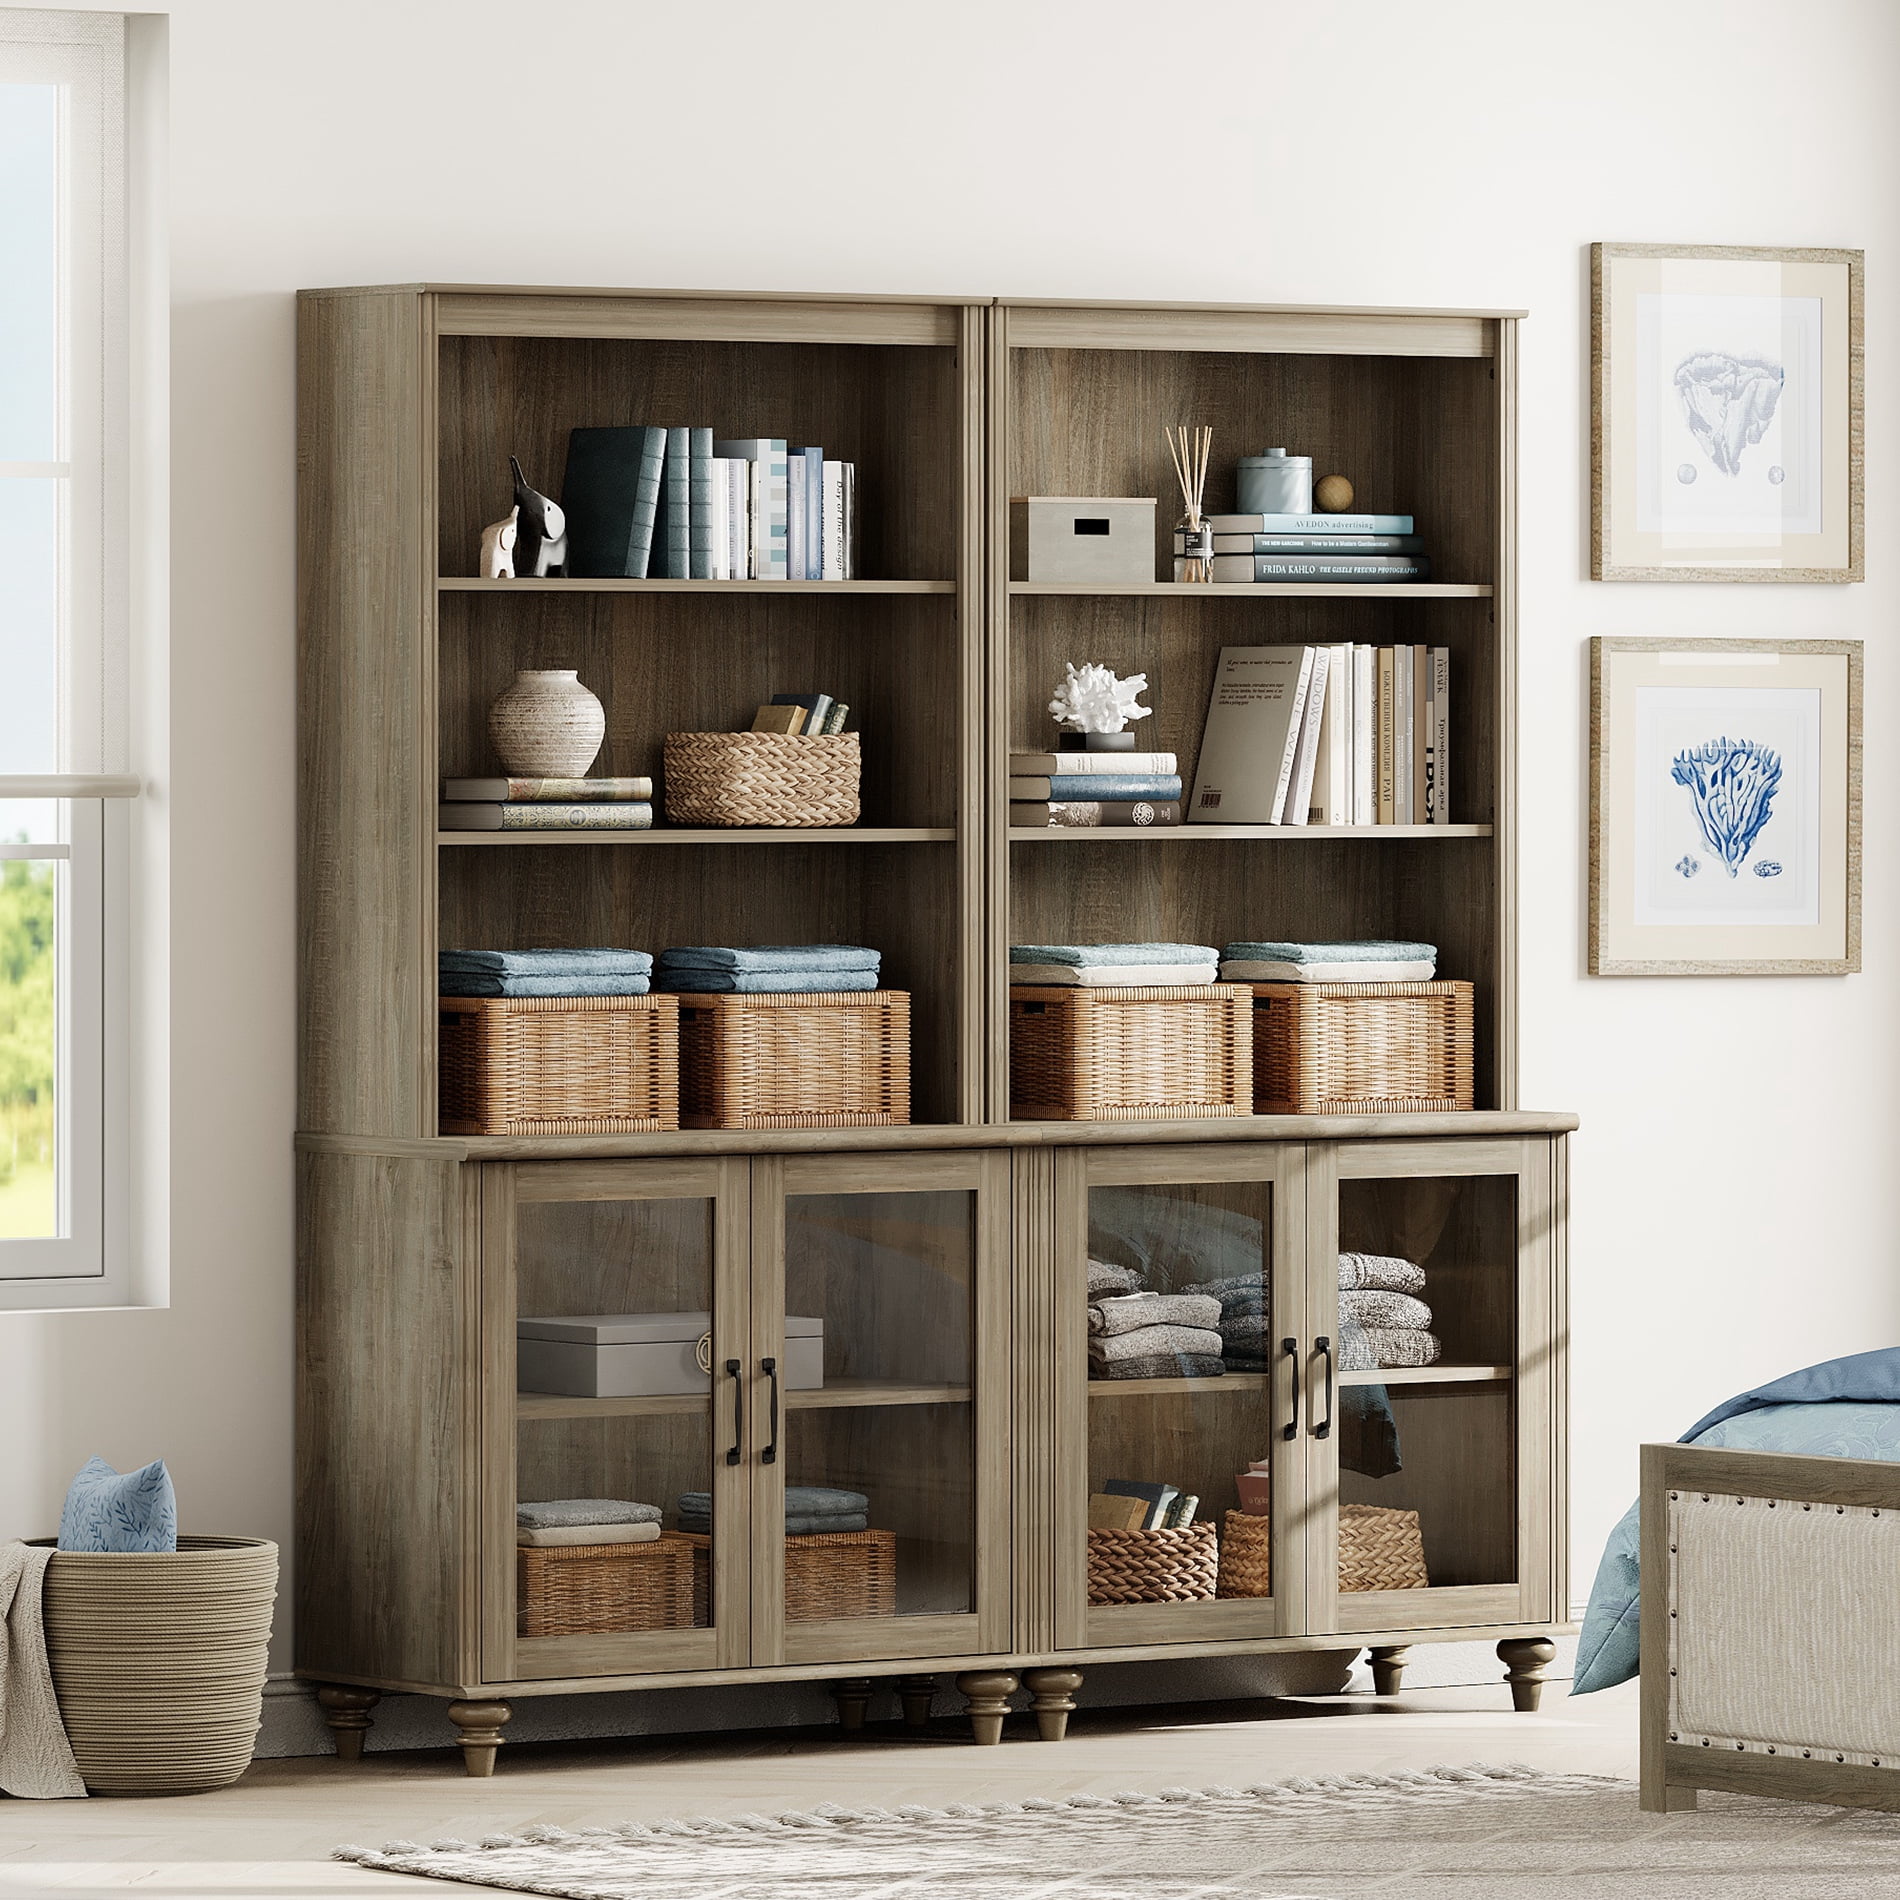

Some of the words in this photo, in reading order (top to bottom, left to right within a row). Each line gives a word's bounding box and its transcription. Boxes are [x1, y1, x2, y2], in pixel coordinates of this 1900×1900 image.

[1294, 520, 1330, 529] AVEDON
[1332, 521, 1374, 530] advertising
[835, 536, 843, 571] design
[1263, 564, 1287, 574] FRIDA
[1288, 564, 1316, 574] KAHLO
[1319, 566, 1330, 574] THE
[1293, 671, 1308, 720] FINE
[1308, 653, 1328, 727] WINDOWS
[1383, 670, 1391, 732] БОЖЕСТВЕННАЯ
[1277, 730, 1298, 800] WINES
[1383, 734, 1391, 772] КОМЕДИЯ
[1438, 717, 1447, 787] Триумфальная
[1383, 778, 1392, 802] РАЙ
[1438, 789, 1446, 811] арка
